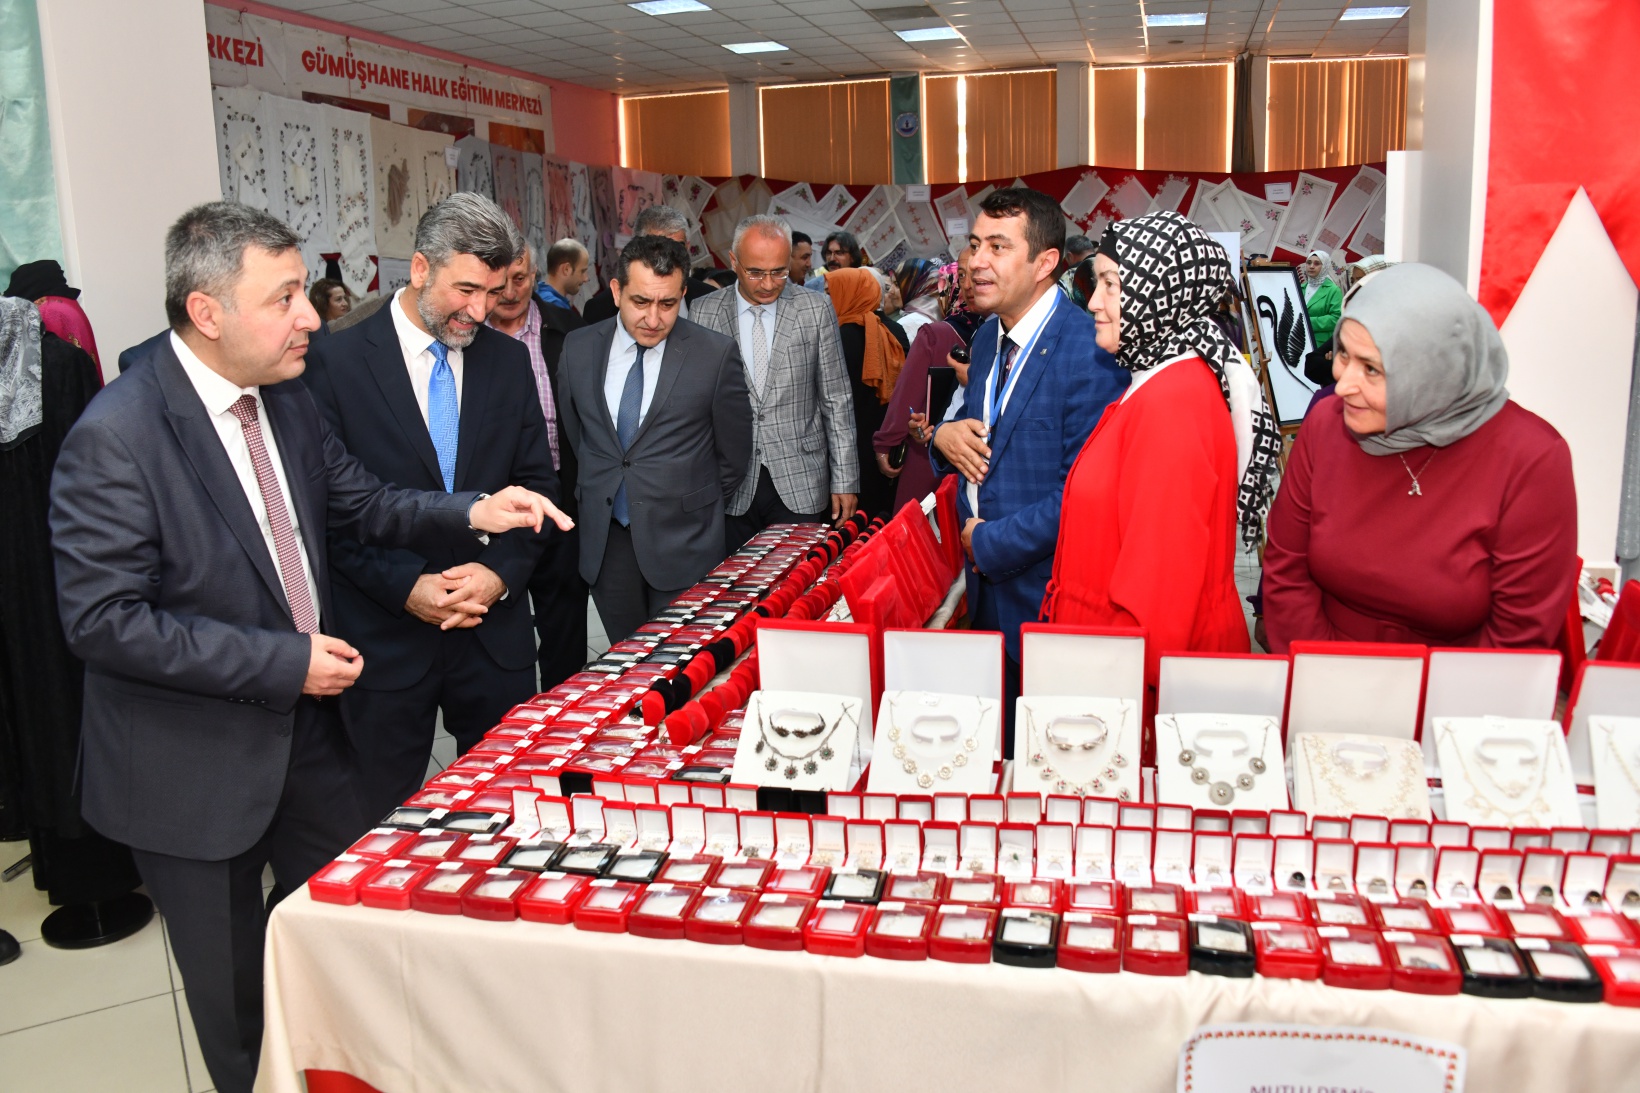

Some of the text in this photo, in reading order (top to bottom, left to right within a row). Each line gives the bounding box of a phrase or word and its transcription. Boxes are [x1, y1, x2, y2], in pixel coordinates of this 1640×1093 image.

[302, 46, 543, 115] GÜMÜŞHANE HALK EĞİTİM MERKEZİ
